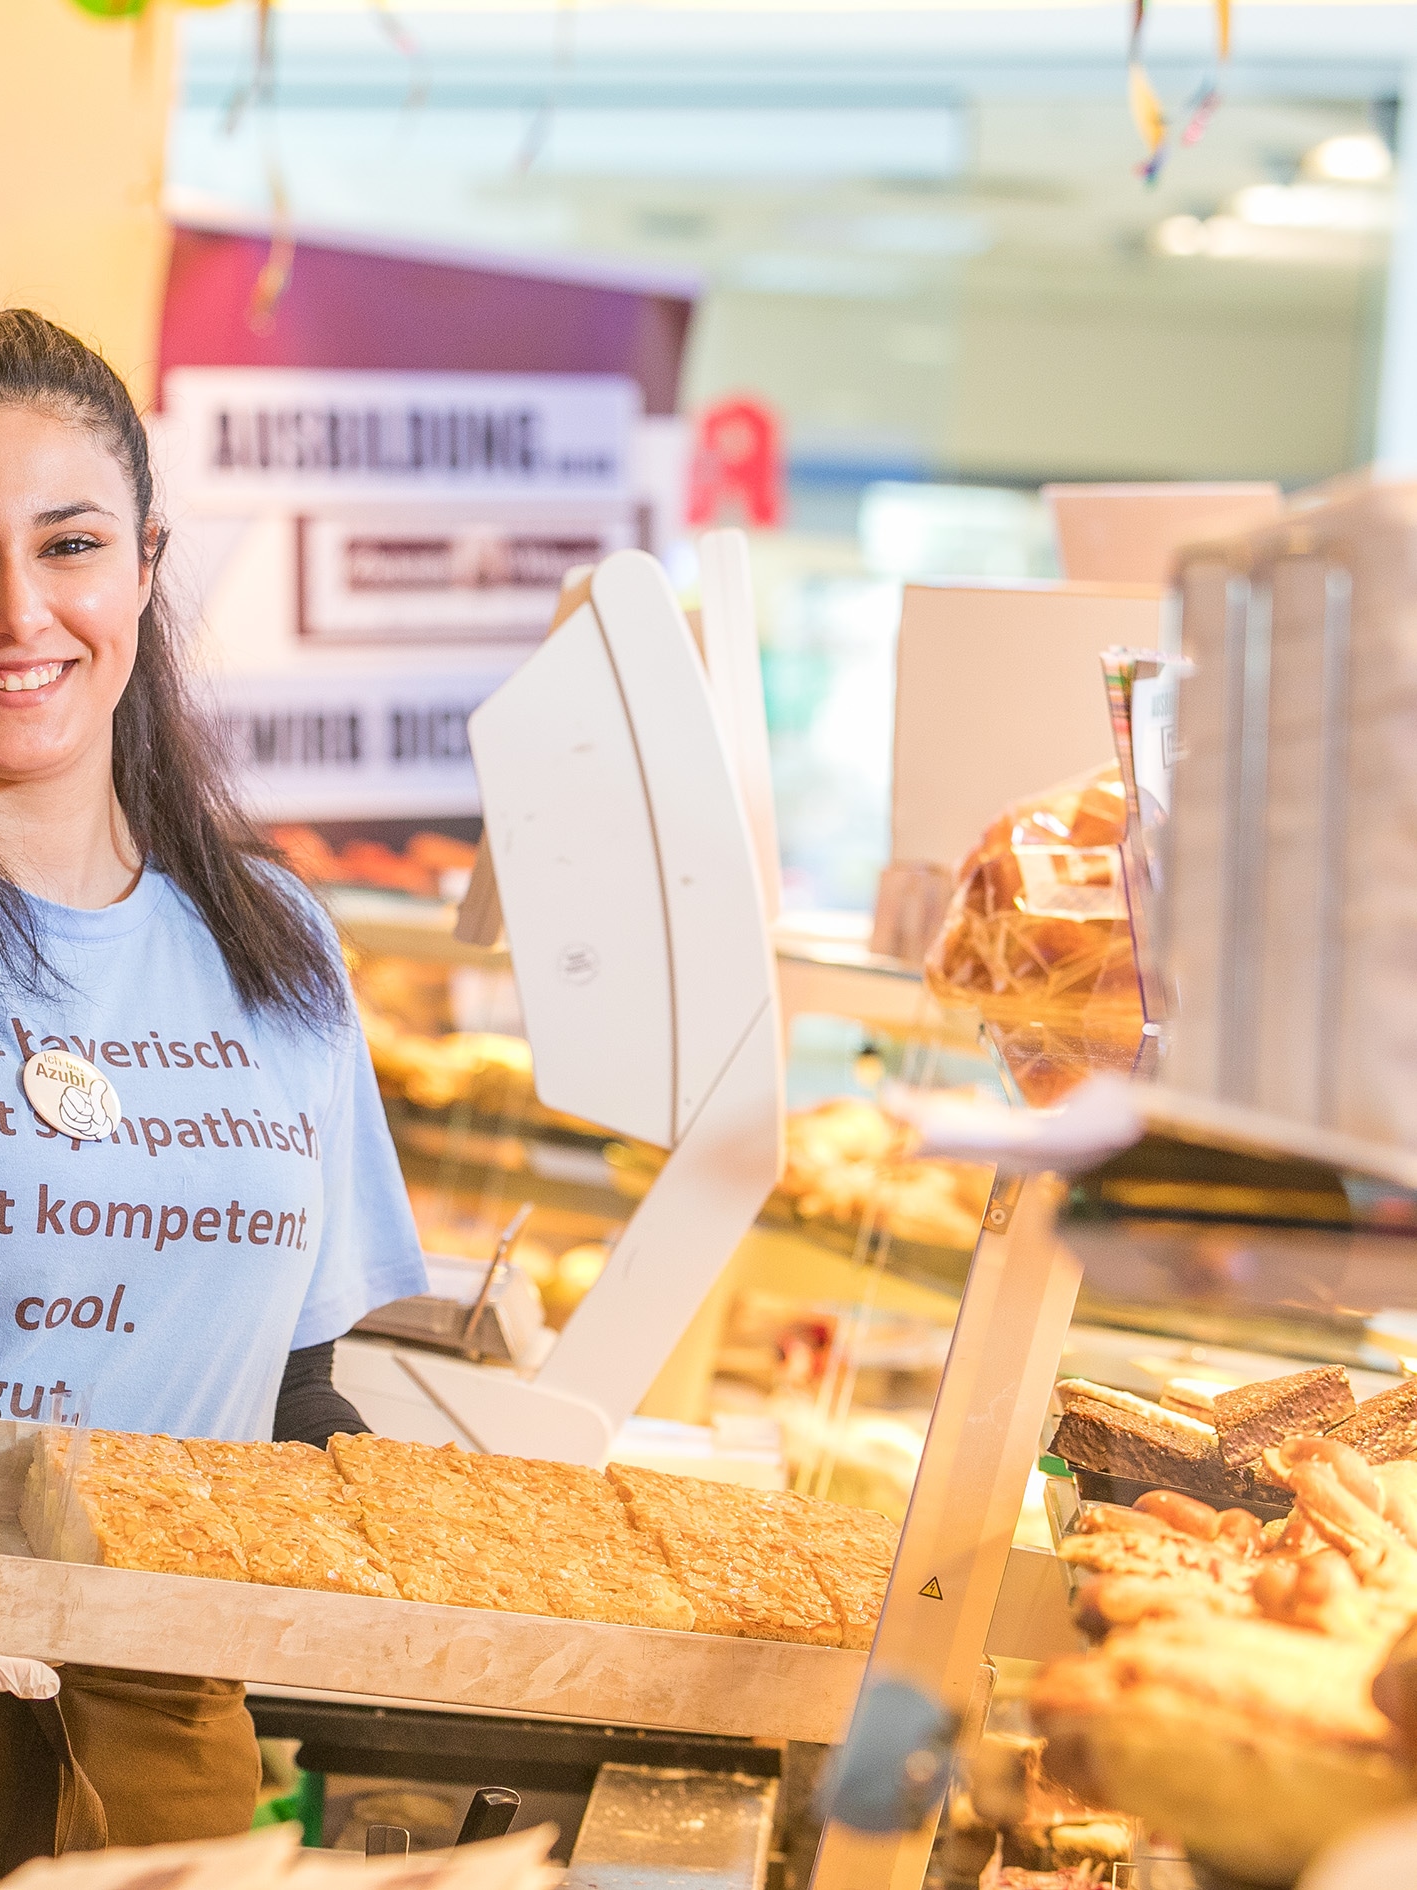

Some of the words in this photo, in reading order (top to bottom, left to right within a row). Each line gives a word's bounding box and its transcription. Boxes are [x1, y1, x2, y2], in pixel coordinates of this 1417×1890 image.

[35, 1062, 86, 1088] Azubi
[36, 1184, 309, 1253] kompetent.
[14, 1284, 136, 1334] cool.
